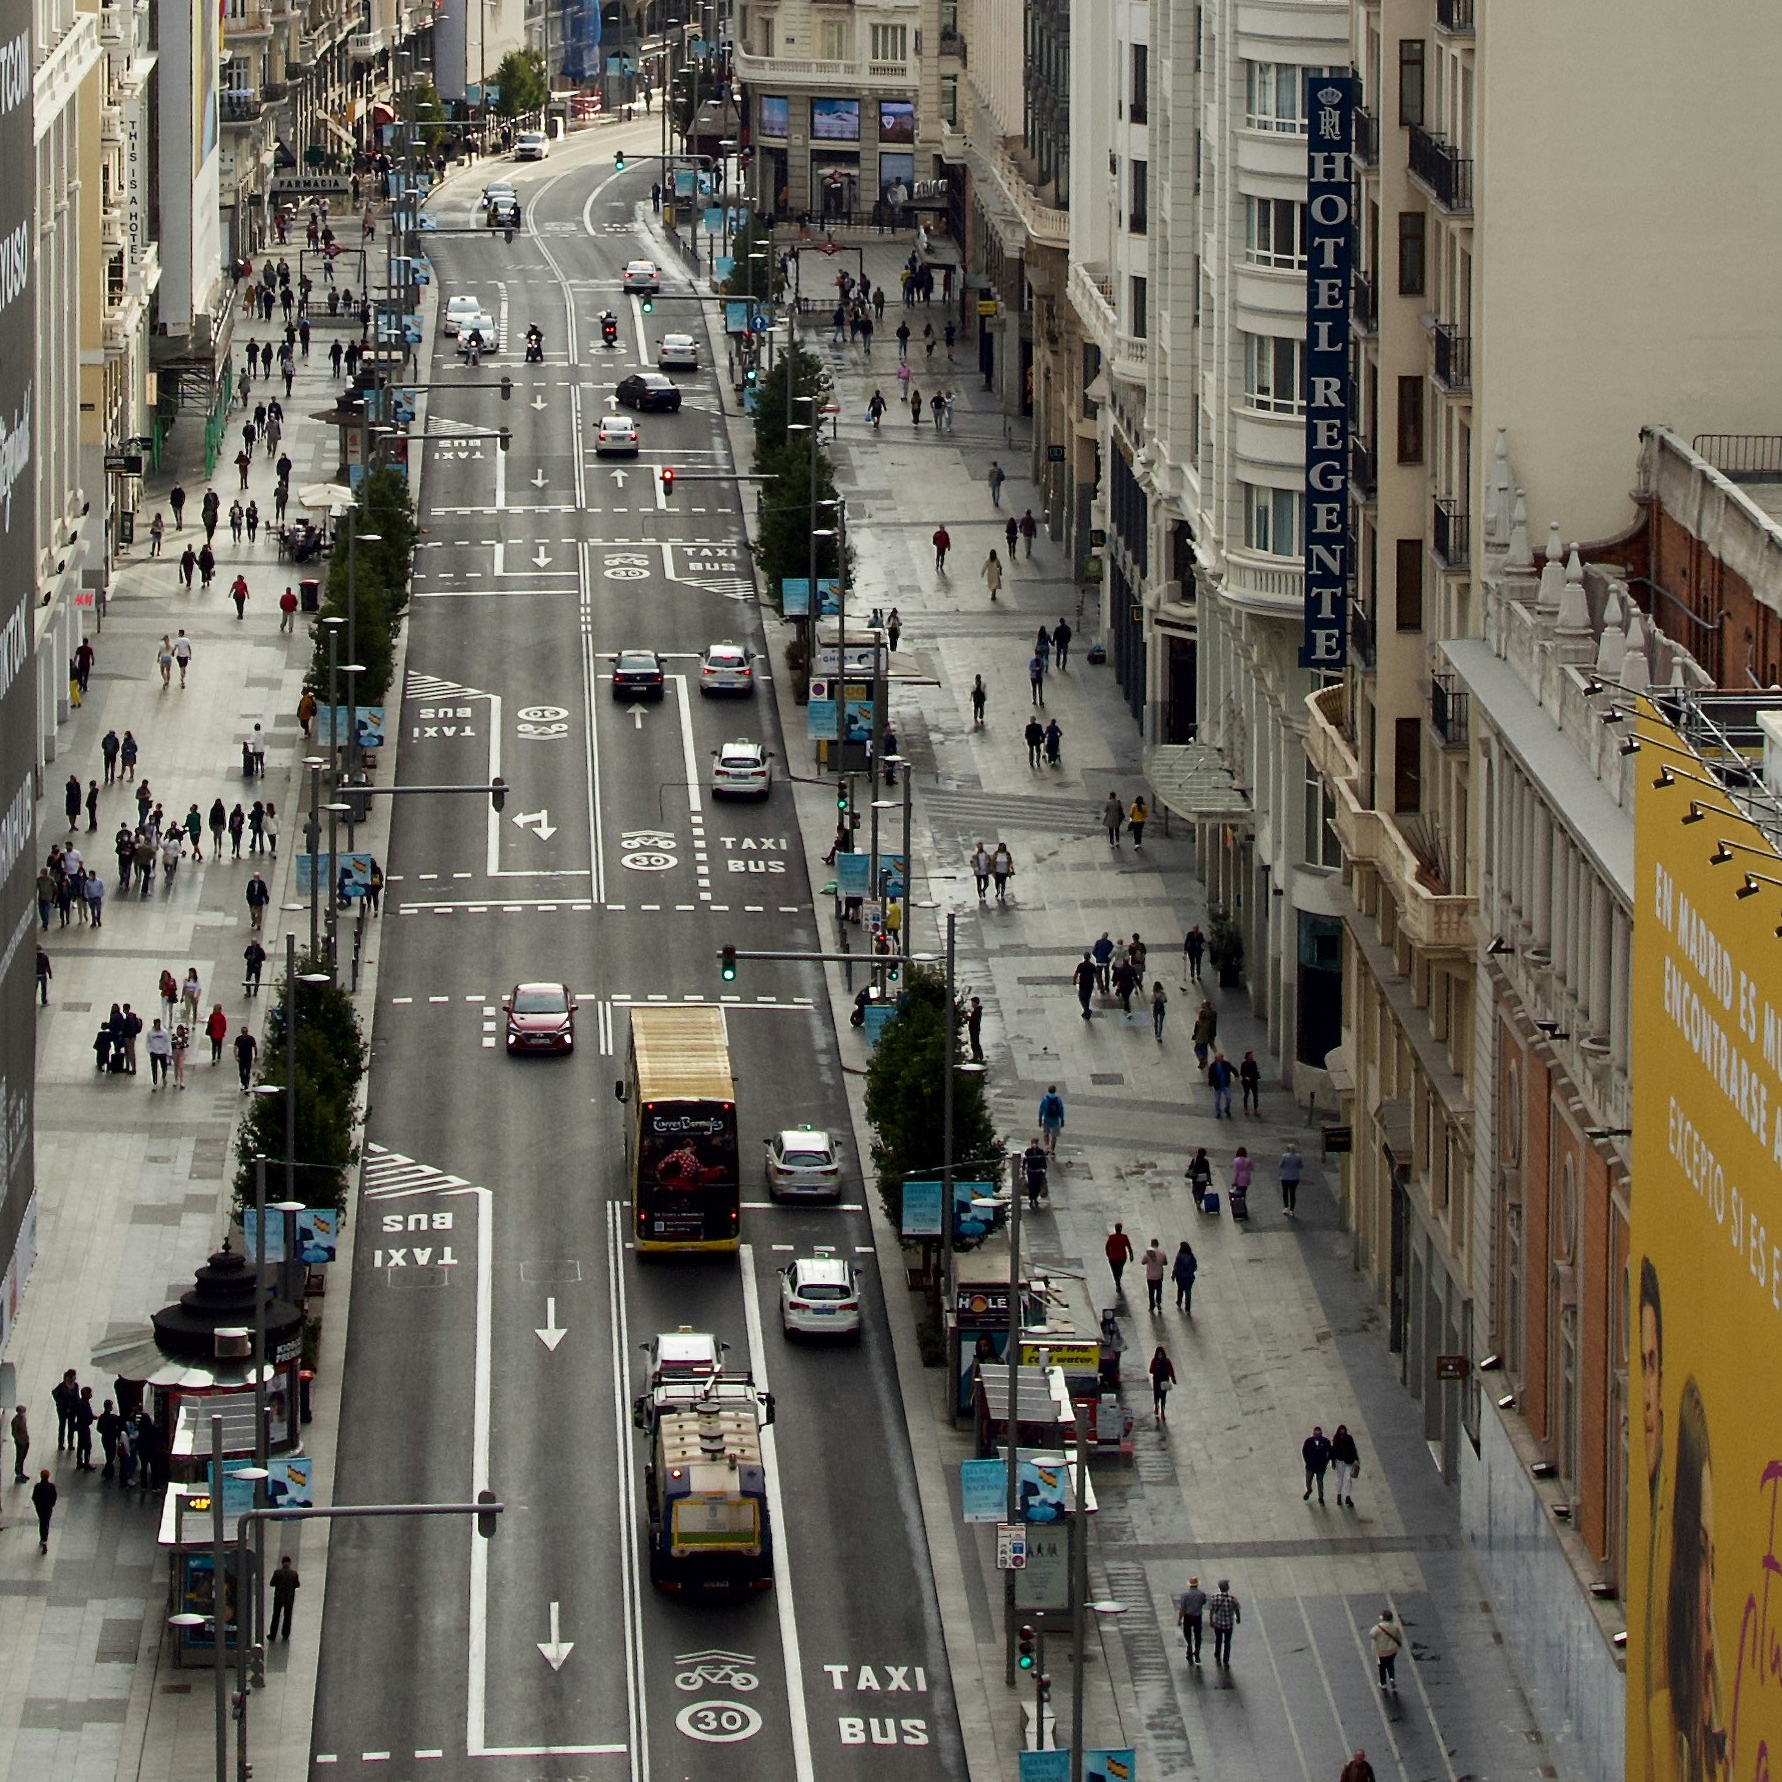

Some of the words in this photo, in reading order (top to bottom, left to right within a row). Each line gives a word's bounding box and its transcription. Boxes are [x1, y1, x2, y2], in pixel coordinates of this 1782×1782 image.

[128, 120, 137, 162] THIS
[129, 168, 138, 189] IS
[279, 179, 340, 189] FARMACIA
[129, 196, 137, 206] A
[129, 211, 138, 265] HOTEL
[1308, 152, 1349, 352] HOTEL
[1309, 377, 1347, 661] REGENTE
[683, 547, 738, 557] TAXI
[688, 562, 736, 572] BUS
[419, 707, 472, 719] BUS
[413, 726, 476, 738] TAXI
[720, 837, 787, 850] TAXI
[636, 855, 664, 866] 30
[728, 860, 785, 874] BUS
[1656, 862, 1673, 932] EN
[1678, 892, 1733, 1010] MADRID
[1739, 970, 1757, 1044] ES
[1664, 956, 1768, 1146] ENCONTRARSE
[1669, 1096, 1725, 1225] EXCEPTO
[1731, 1186, 1744, 1256] SI
[1750, 1213, 1766, 1288] ES
[382, 1212, 453, 1233] BUS
[373, 1247, 458, 1268] TAXI
[824, 1665, 928, 1692] TAXI
[697, 1711, 742, 1731] 30
[839, 1717, 930, 1746] BUS
